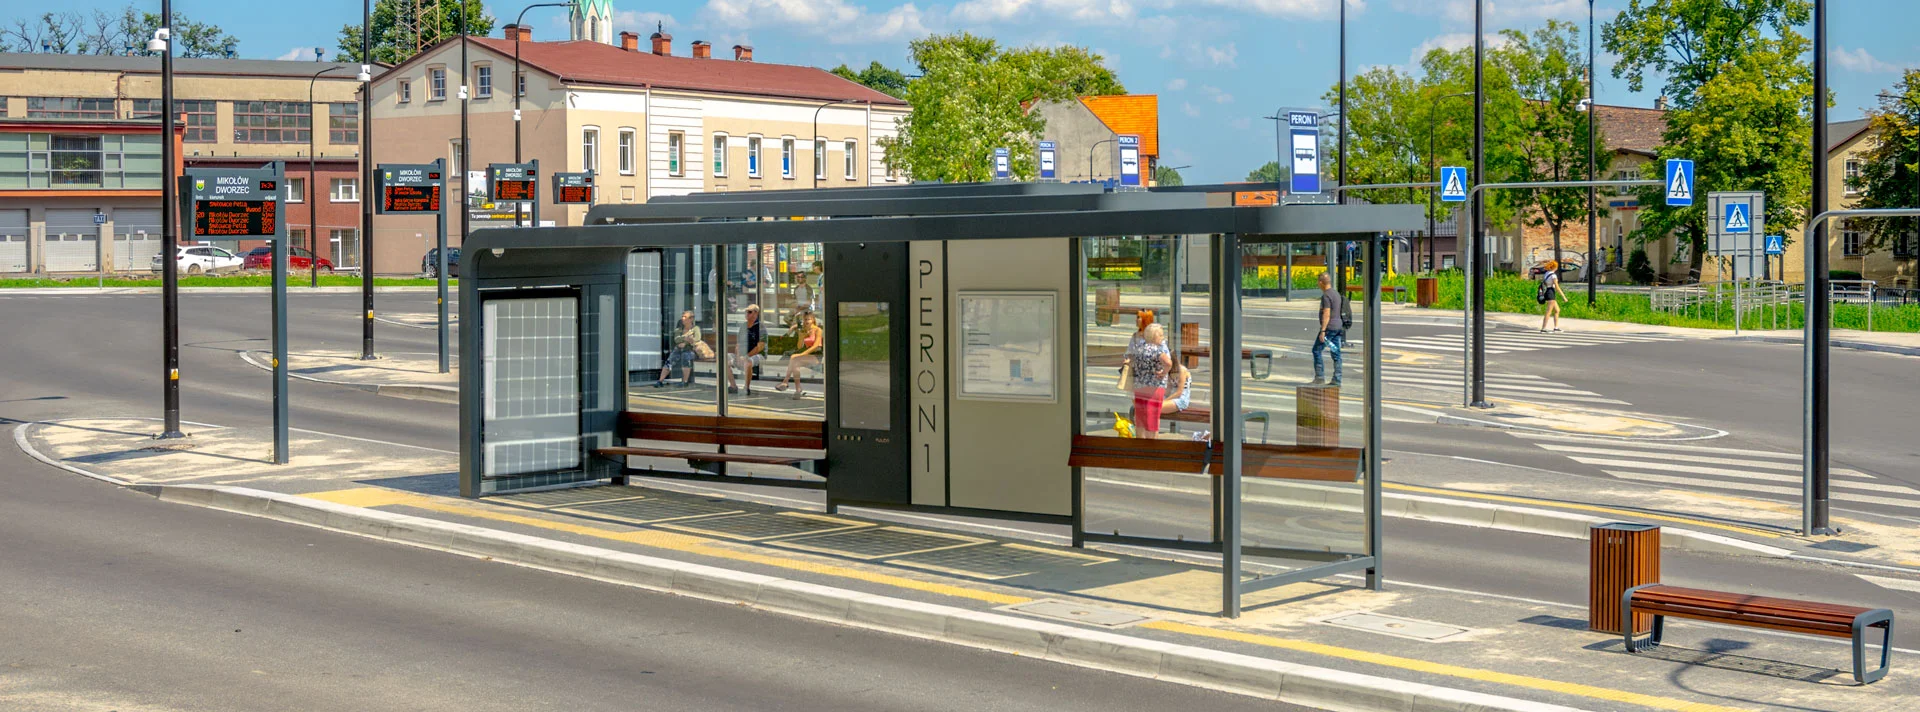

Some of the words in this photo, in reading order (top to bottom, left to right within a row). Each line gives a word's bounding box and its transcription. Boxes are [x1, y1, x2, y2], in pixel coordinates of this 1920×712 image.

[1291, 114, 1312, 124] PERON
[1312, 116, 1316, 124] 1
[216, 176, 250, 184] MIKOŁÓW
[917, 259, 936, 433] PERON
[924, 443, 930, 472] 1
